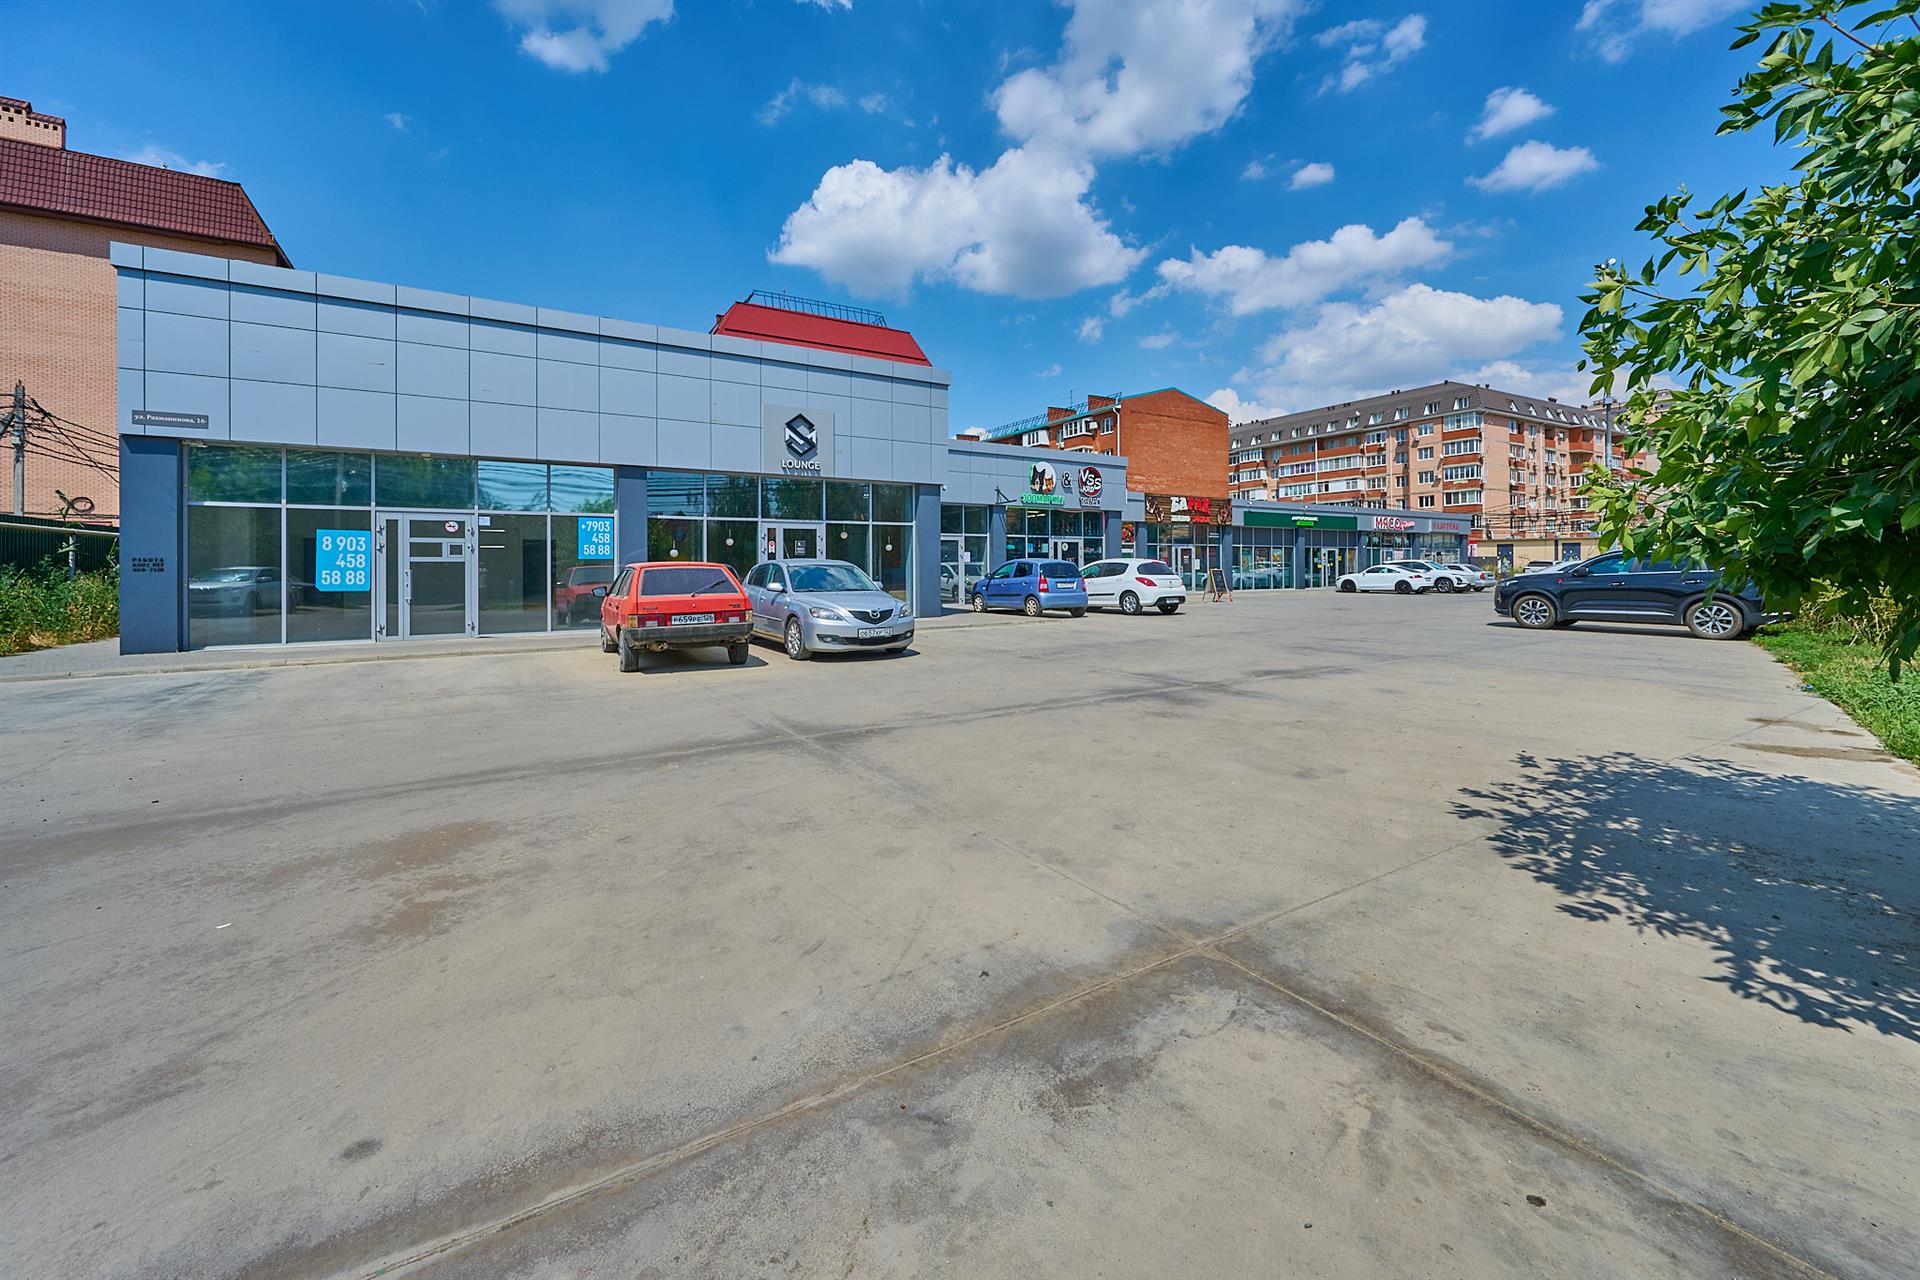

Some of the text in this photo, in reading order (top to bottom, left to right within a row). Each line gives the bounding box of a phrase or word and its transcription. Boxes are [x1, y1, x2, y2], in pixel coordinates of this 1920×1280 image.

[781, 458, 821, 471] LOUNGE
[1062, 471, 1073, 488] &
[580, 520, 610, 532] +7903
[1374, 516, 1401, 531] МЯСО
[321, 536, 366, 551] 8 903
[591, 532, 610, 543] 458
[583, 544, 610, 555] 58 88
[335, 553, 366, 568] 458
[321, 570, 365, 585] 58 88
